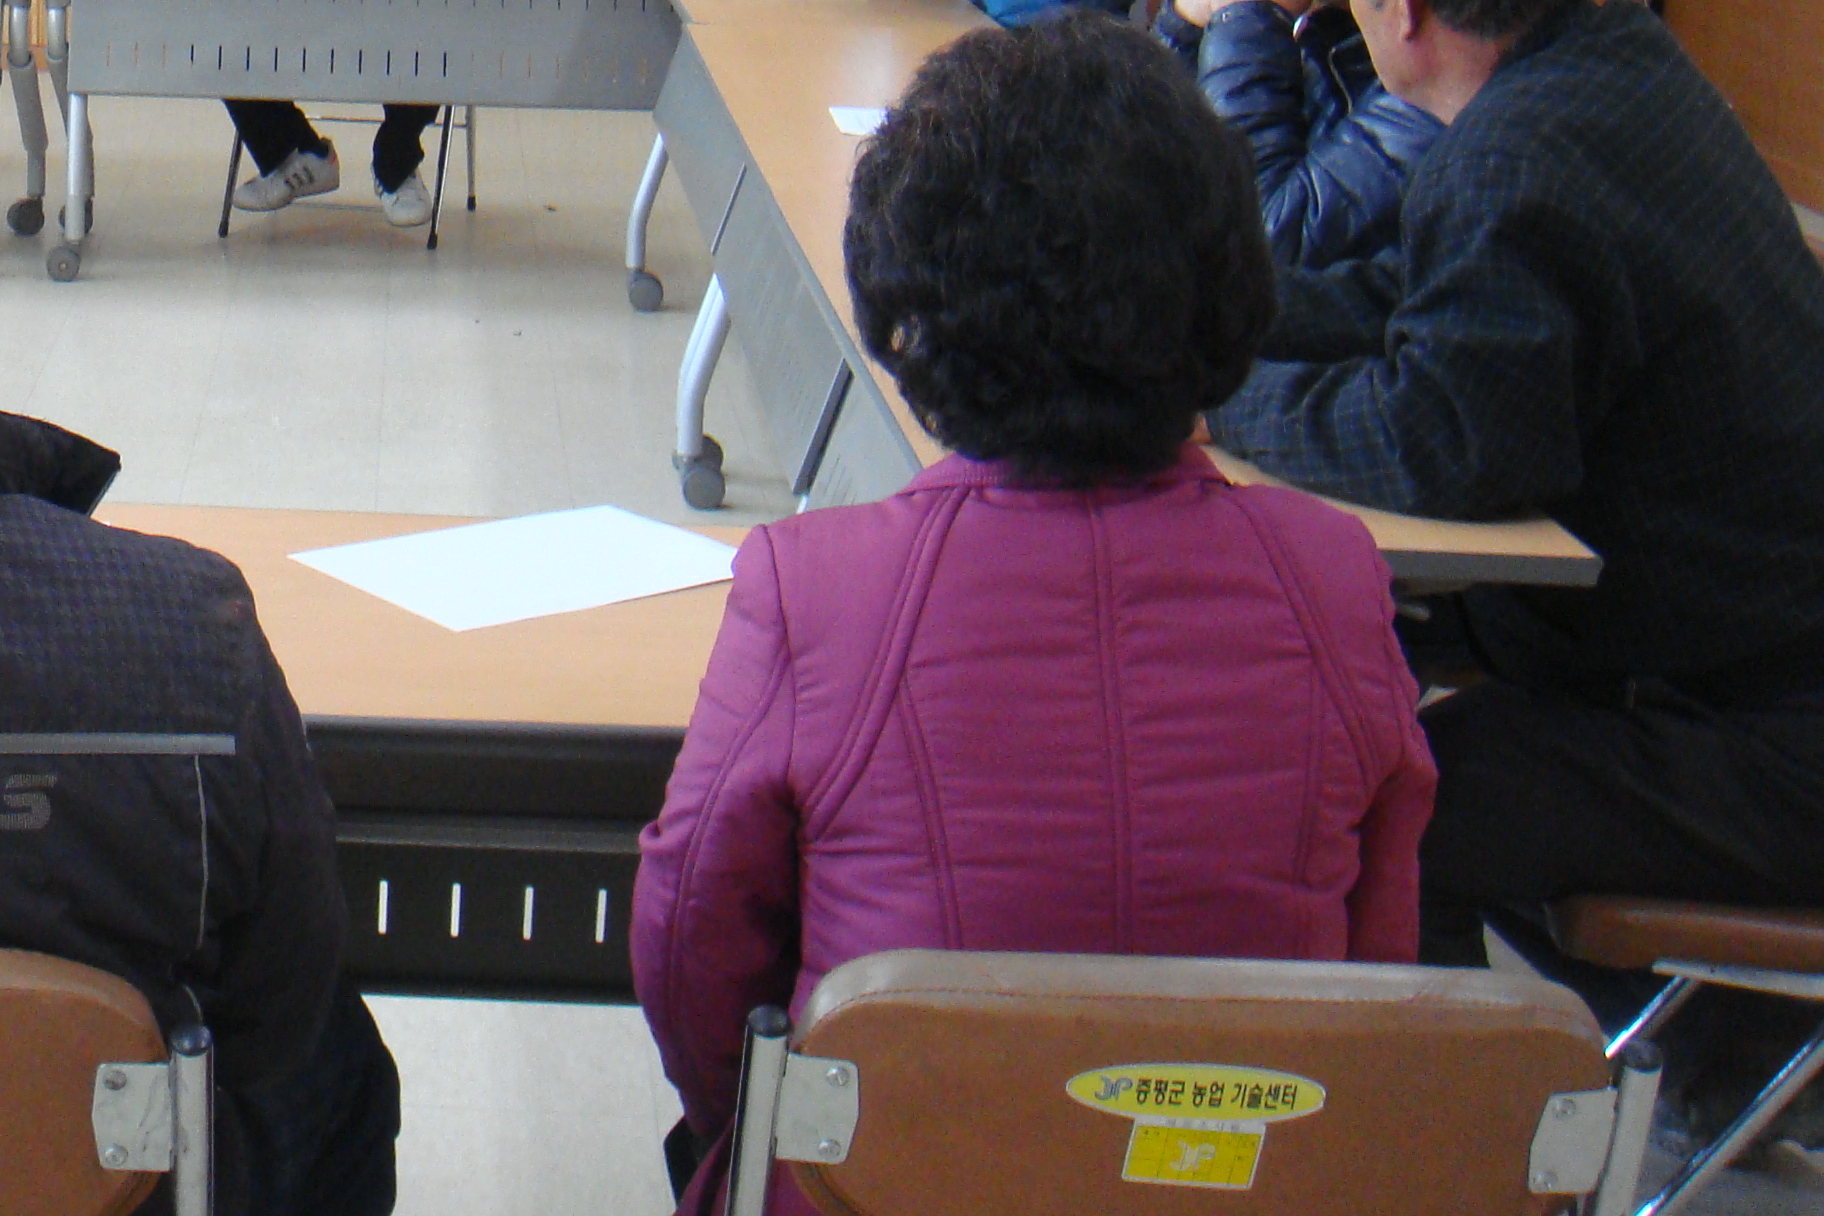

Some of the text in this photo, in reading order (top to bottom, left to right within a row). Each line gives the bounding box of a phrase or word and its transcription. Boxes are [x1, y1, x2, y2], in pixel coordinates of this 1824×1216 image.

[1135, 1077, 1298, 1110] 증평군 농업 기술센터
